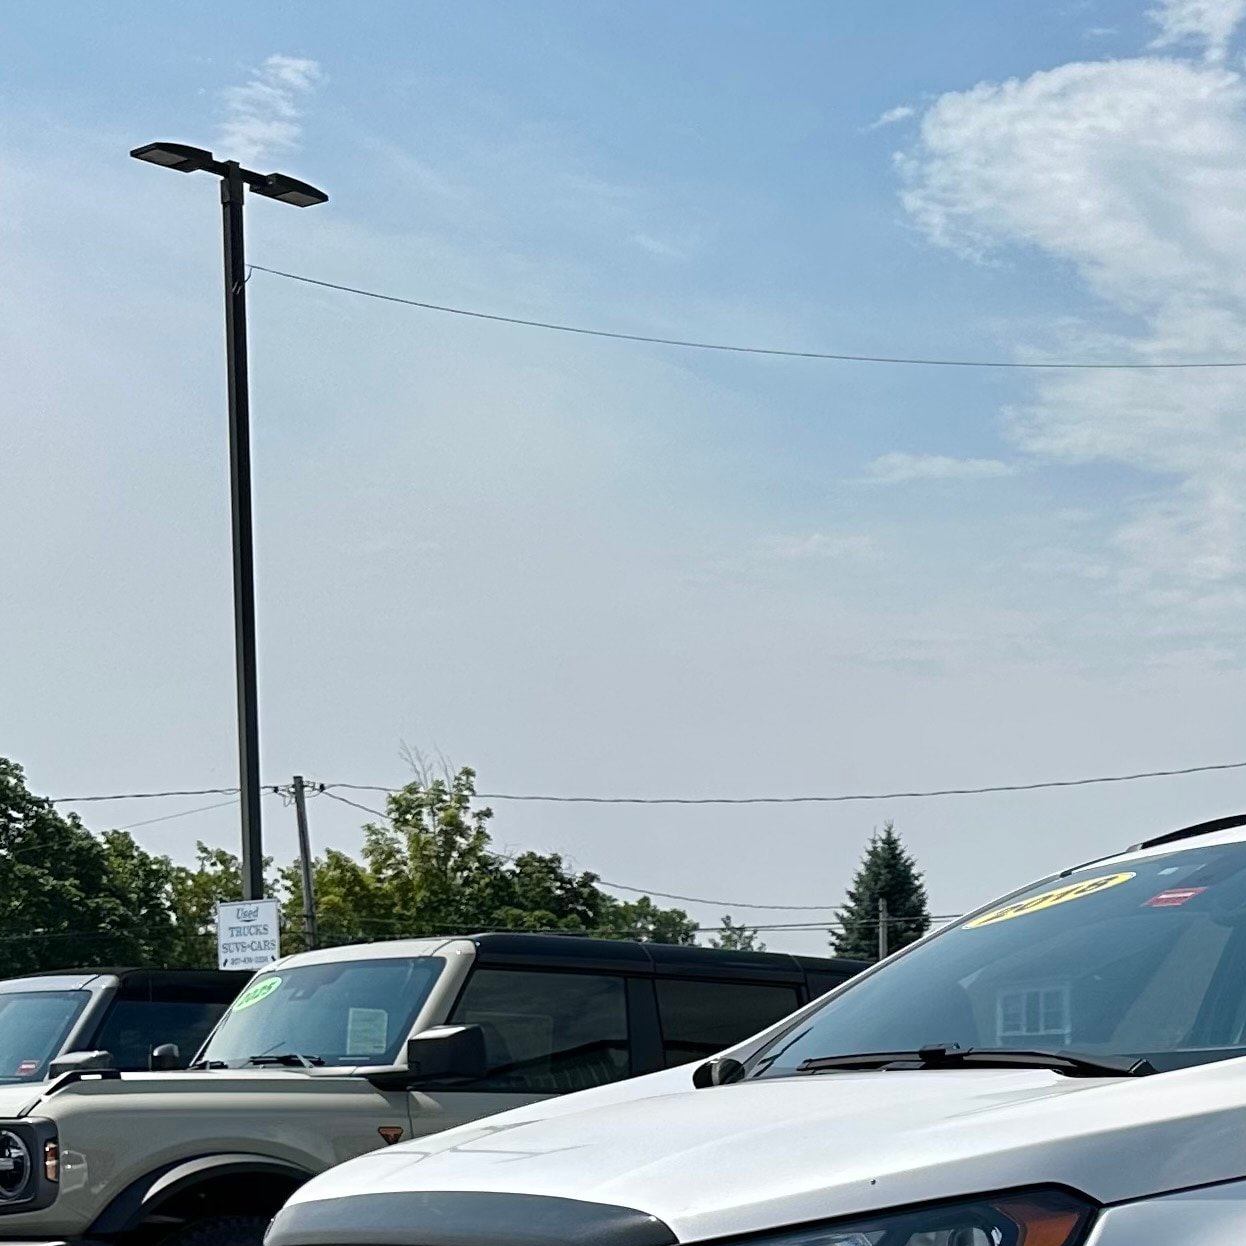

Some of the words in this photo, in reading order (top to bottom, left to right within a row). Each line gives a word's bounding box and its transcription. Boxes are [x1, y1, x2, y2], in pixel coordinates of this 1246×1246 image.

[978, 875, 1120, 926] 2018
[237, 907, 259, 919] Used
[229, 924, 269, 938] TRUCKS
